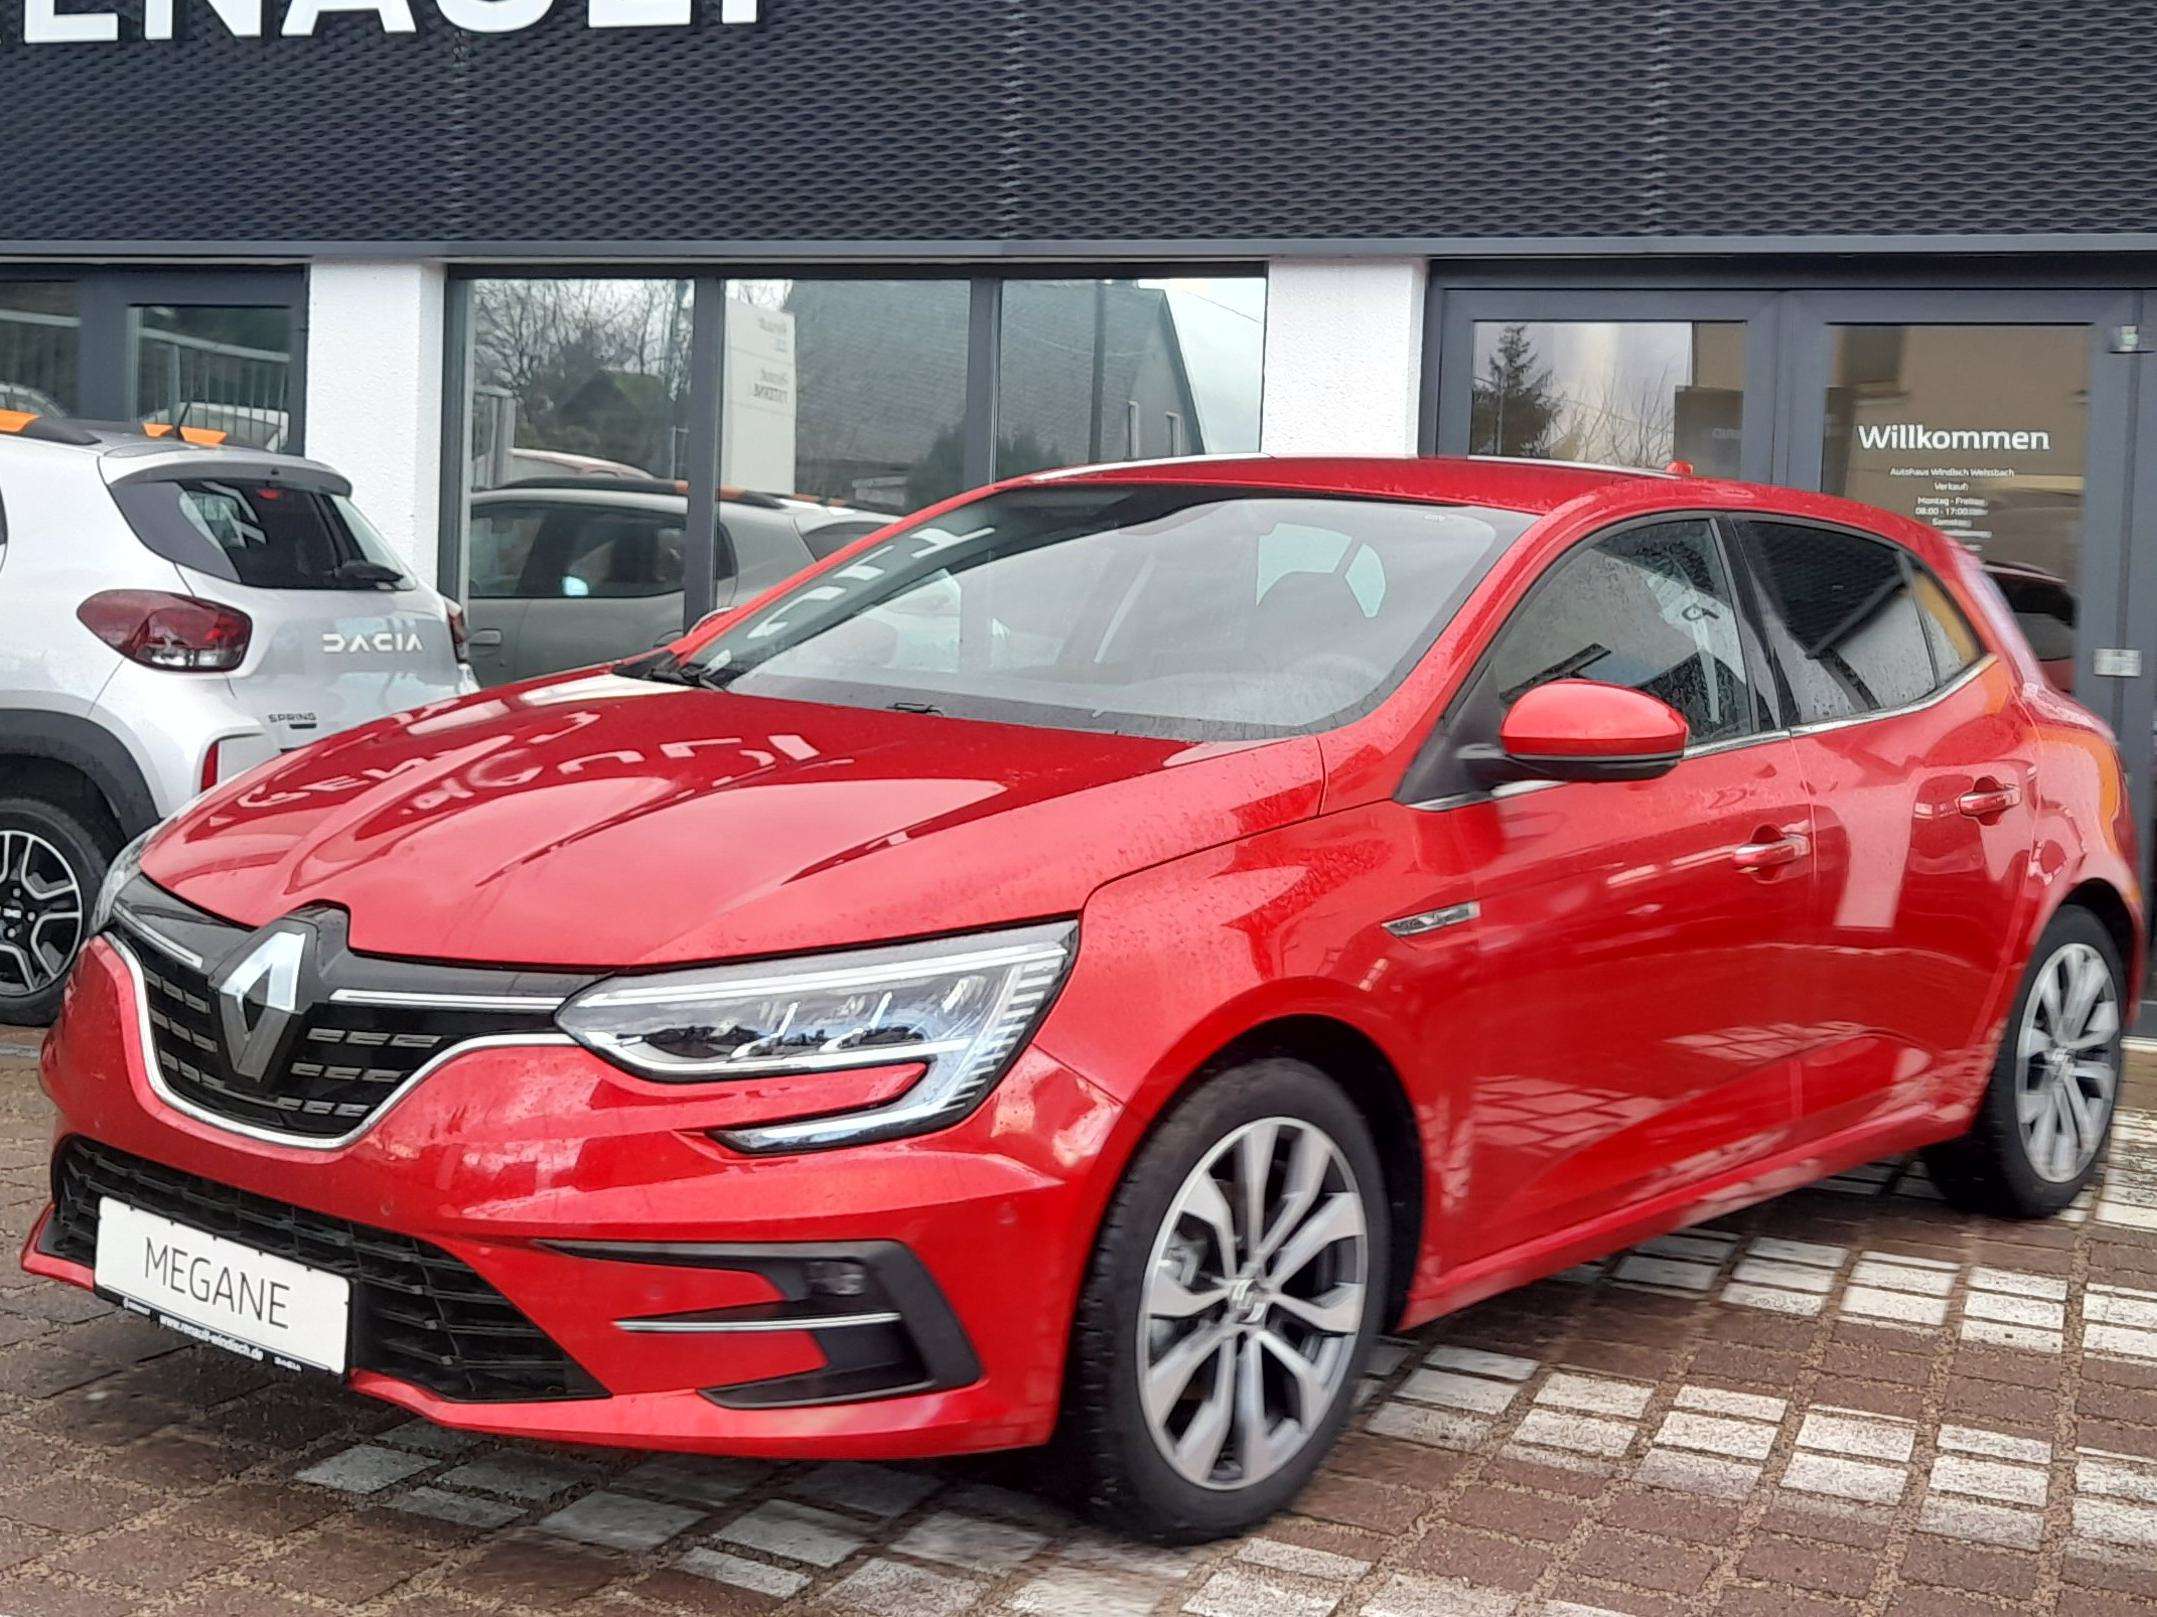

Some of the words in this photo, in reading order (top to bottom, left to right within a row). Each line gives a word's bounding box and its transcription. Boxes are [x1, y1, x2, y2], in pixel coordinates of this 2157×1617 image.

[1858, 424, 2050, 450] Willkommen
[1889, 468, 1929, 477] Autohaus
[322, 633, 424, 652] DACIA
[145, 1237, 290, 1329] MEGANE
